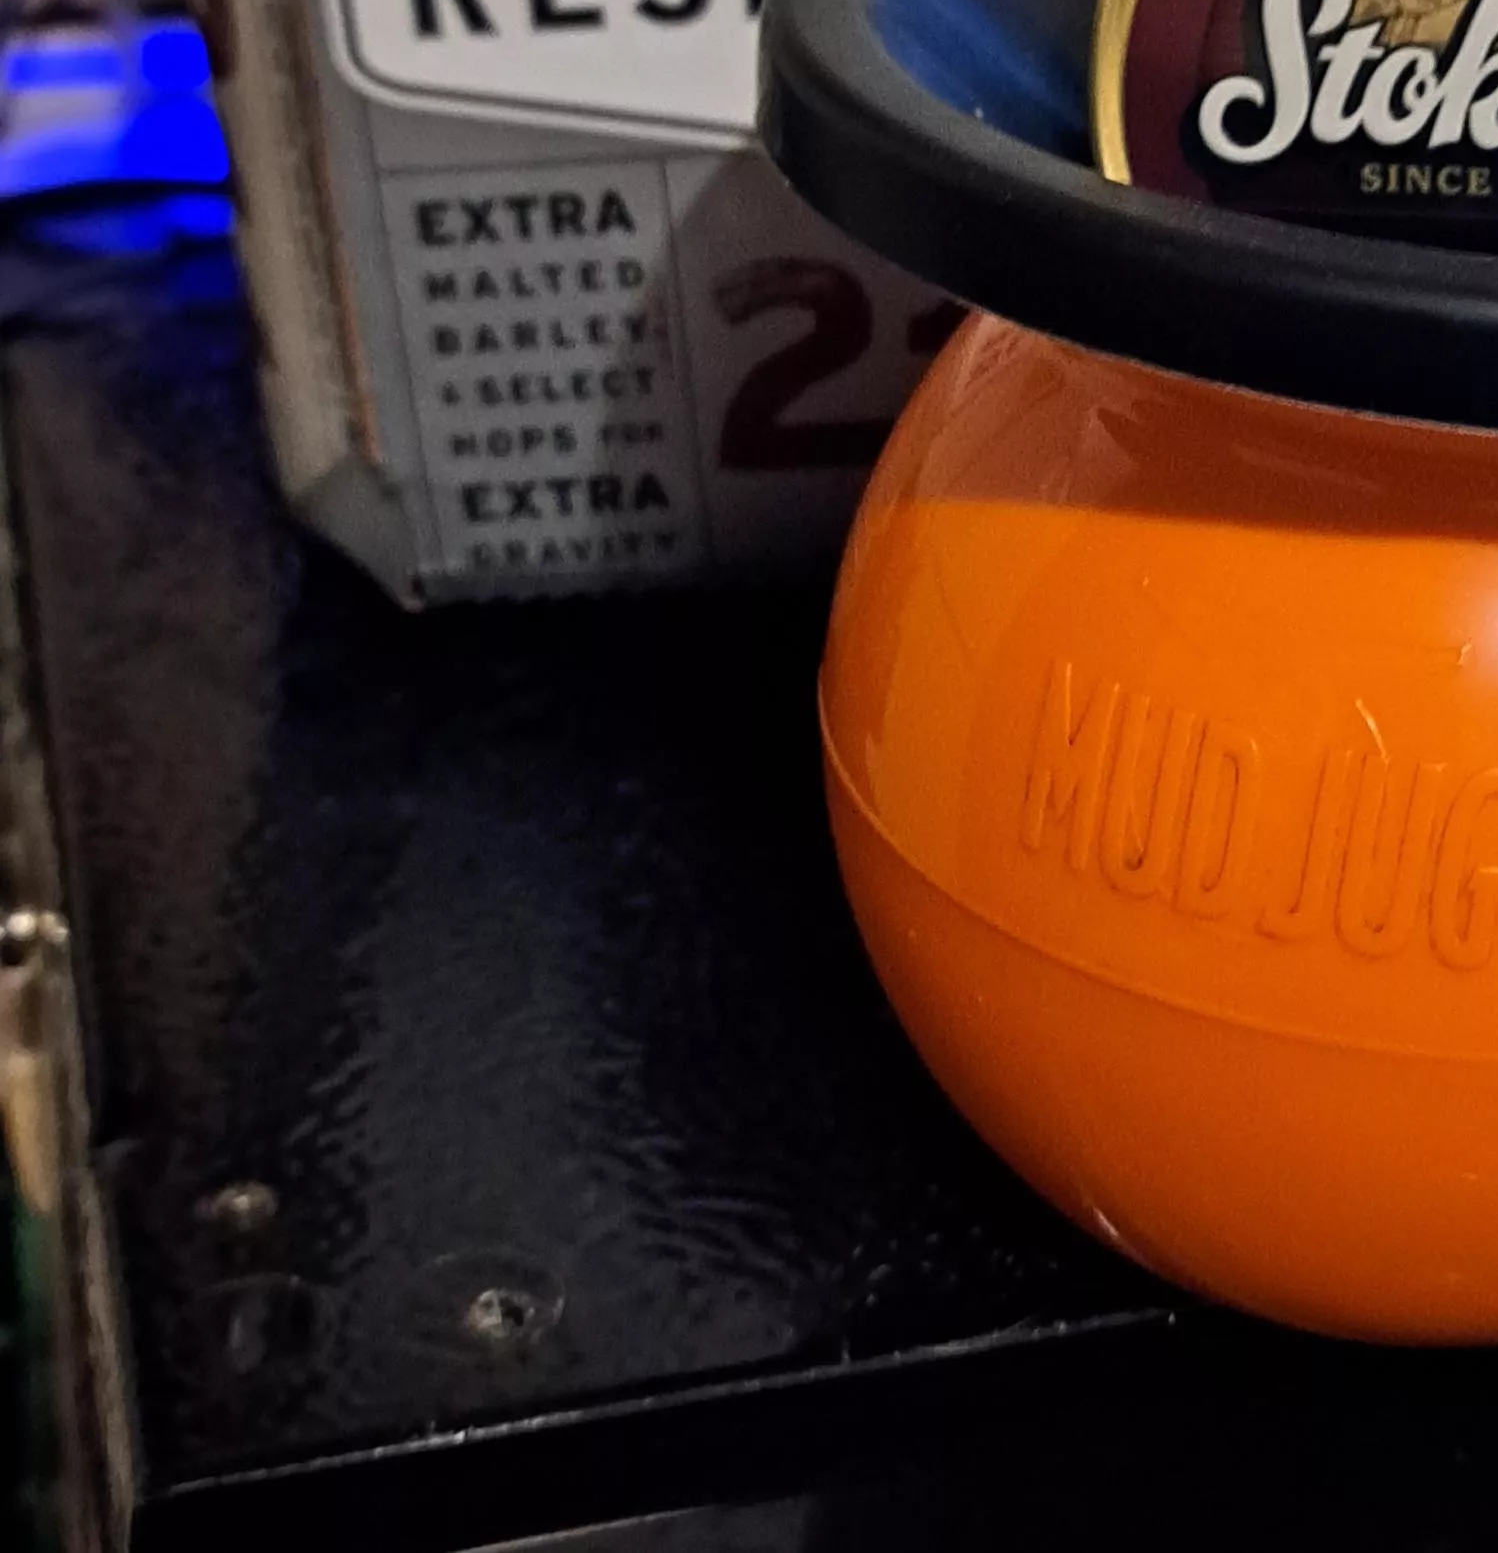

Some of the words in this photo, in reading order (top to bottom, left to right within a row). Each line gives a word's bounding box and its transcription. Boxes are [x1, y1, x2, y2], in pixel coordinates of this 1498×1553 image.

[1360, 162, 1491, 198] SINCE
[414, 188, 636, 248] EXTRA
[424, 256, 646, 303] MALTED
[432, 312, 649, 356] BARLEY
[478, 365, 656, 408] SELECT
[450, 423, 580, 460] HOPS
[460, 471, 671, 524] EXTRA
[471, 529, 677, 571] GRAVITY
[1018, 656, 1260, 924] MUD
